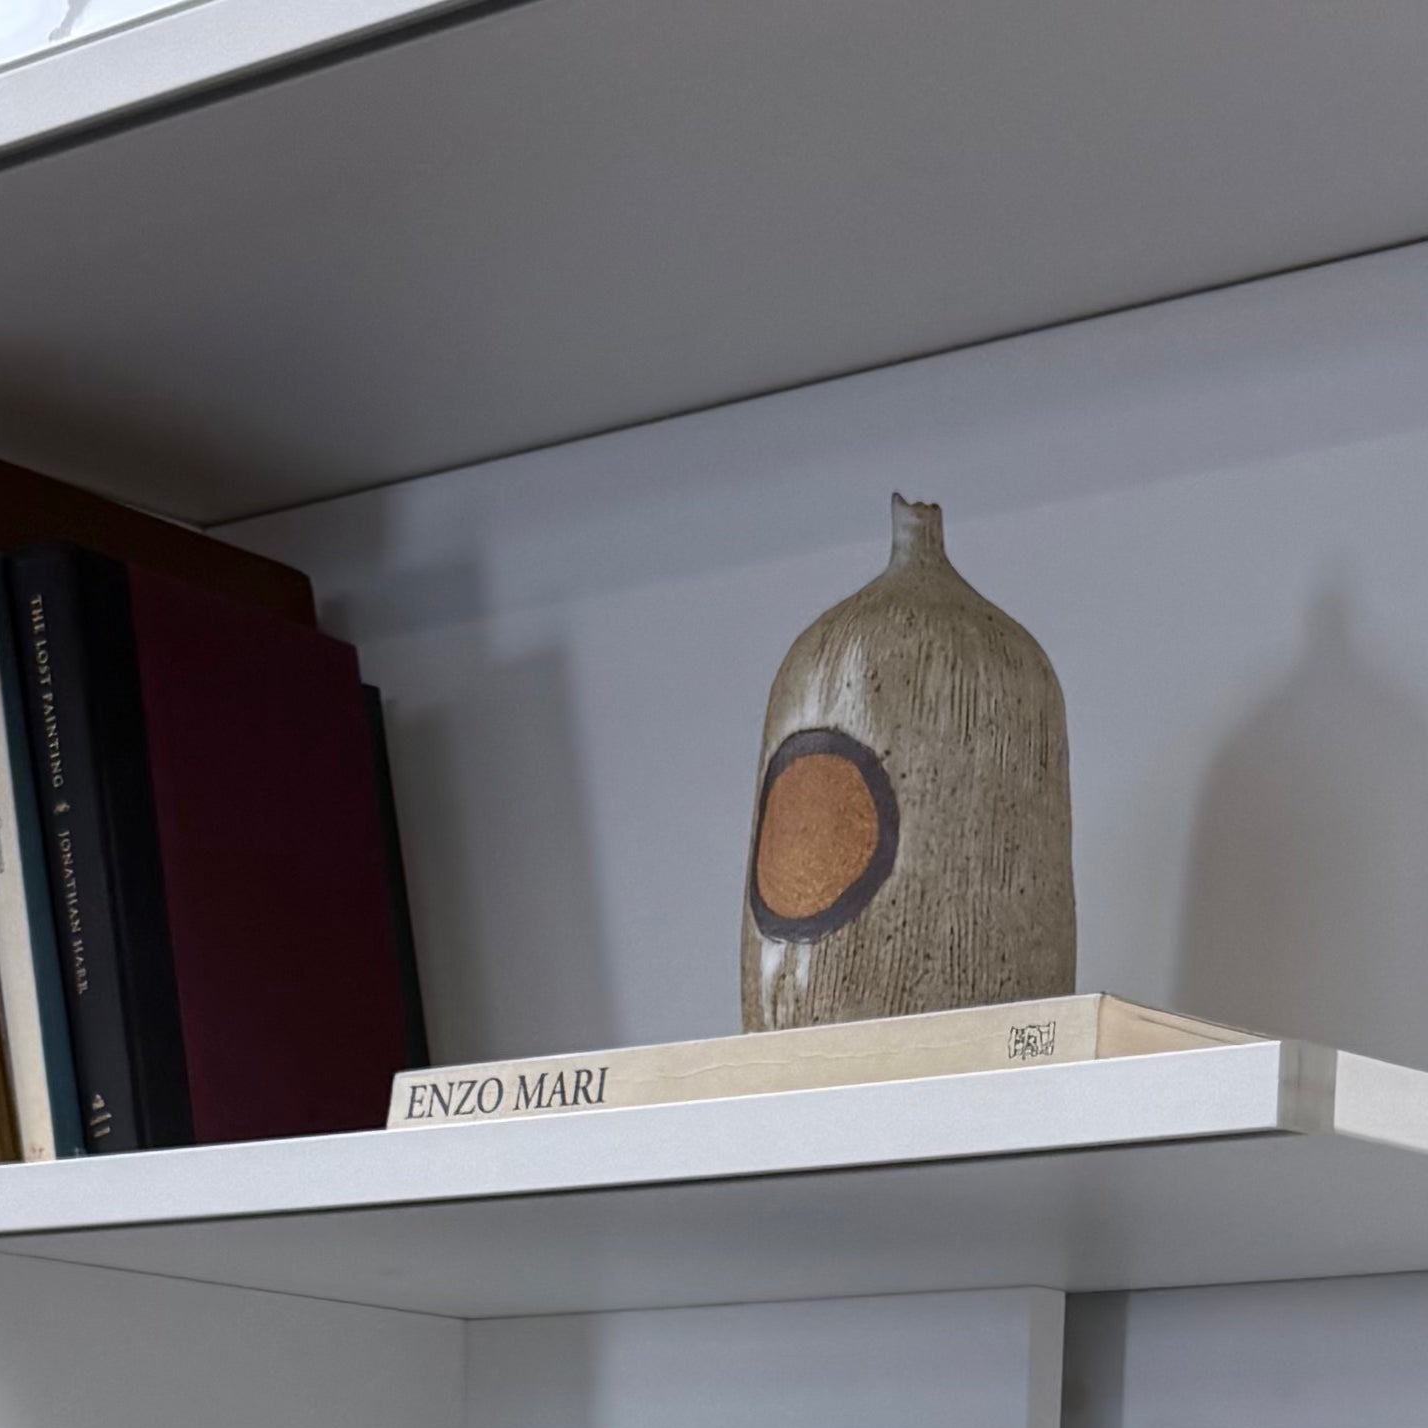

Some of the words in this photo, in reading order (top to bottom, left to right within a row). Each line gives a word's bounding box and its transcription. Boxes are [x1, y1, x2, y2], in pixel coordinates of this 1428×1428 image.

[30, 593, 45, 634] THE
[35, 639, 53, 686] LOST
[40, 692, 65, 789] PAINTING
[56, 830, 83, 936] JONATHAN
[404, 1076, 504, 1120] ENZO
[513, 1066, 610, 1111] MARI
